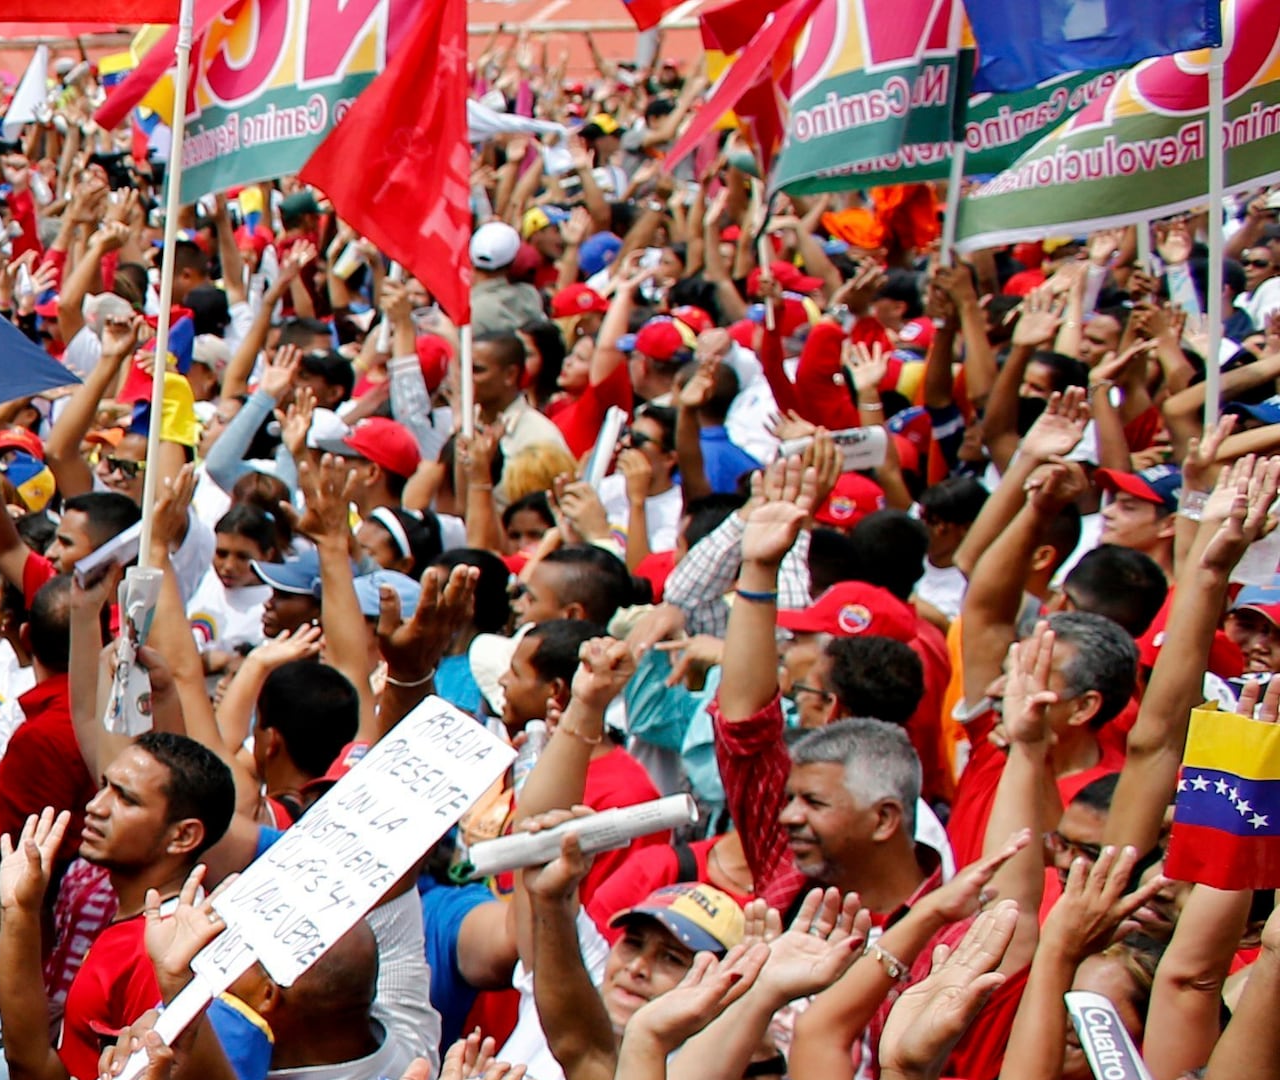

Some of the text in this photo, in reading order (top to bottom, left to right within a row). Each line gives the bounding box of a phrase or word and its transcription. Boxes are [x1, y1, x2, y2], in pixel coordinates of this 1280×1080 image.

[413, 710, 493, 763] ARAGUA
[366, 737, 470, 816] PRESENTE
[369, 806, 408, 834] LA
[1083, 1008, 1126, 1080] Cuatro
